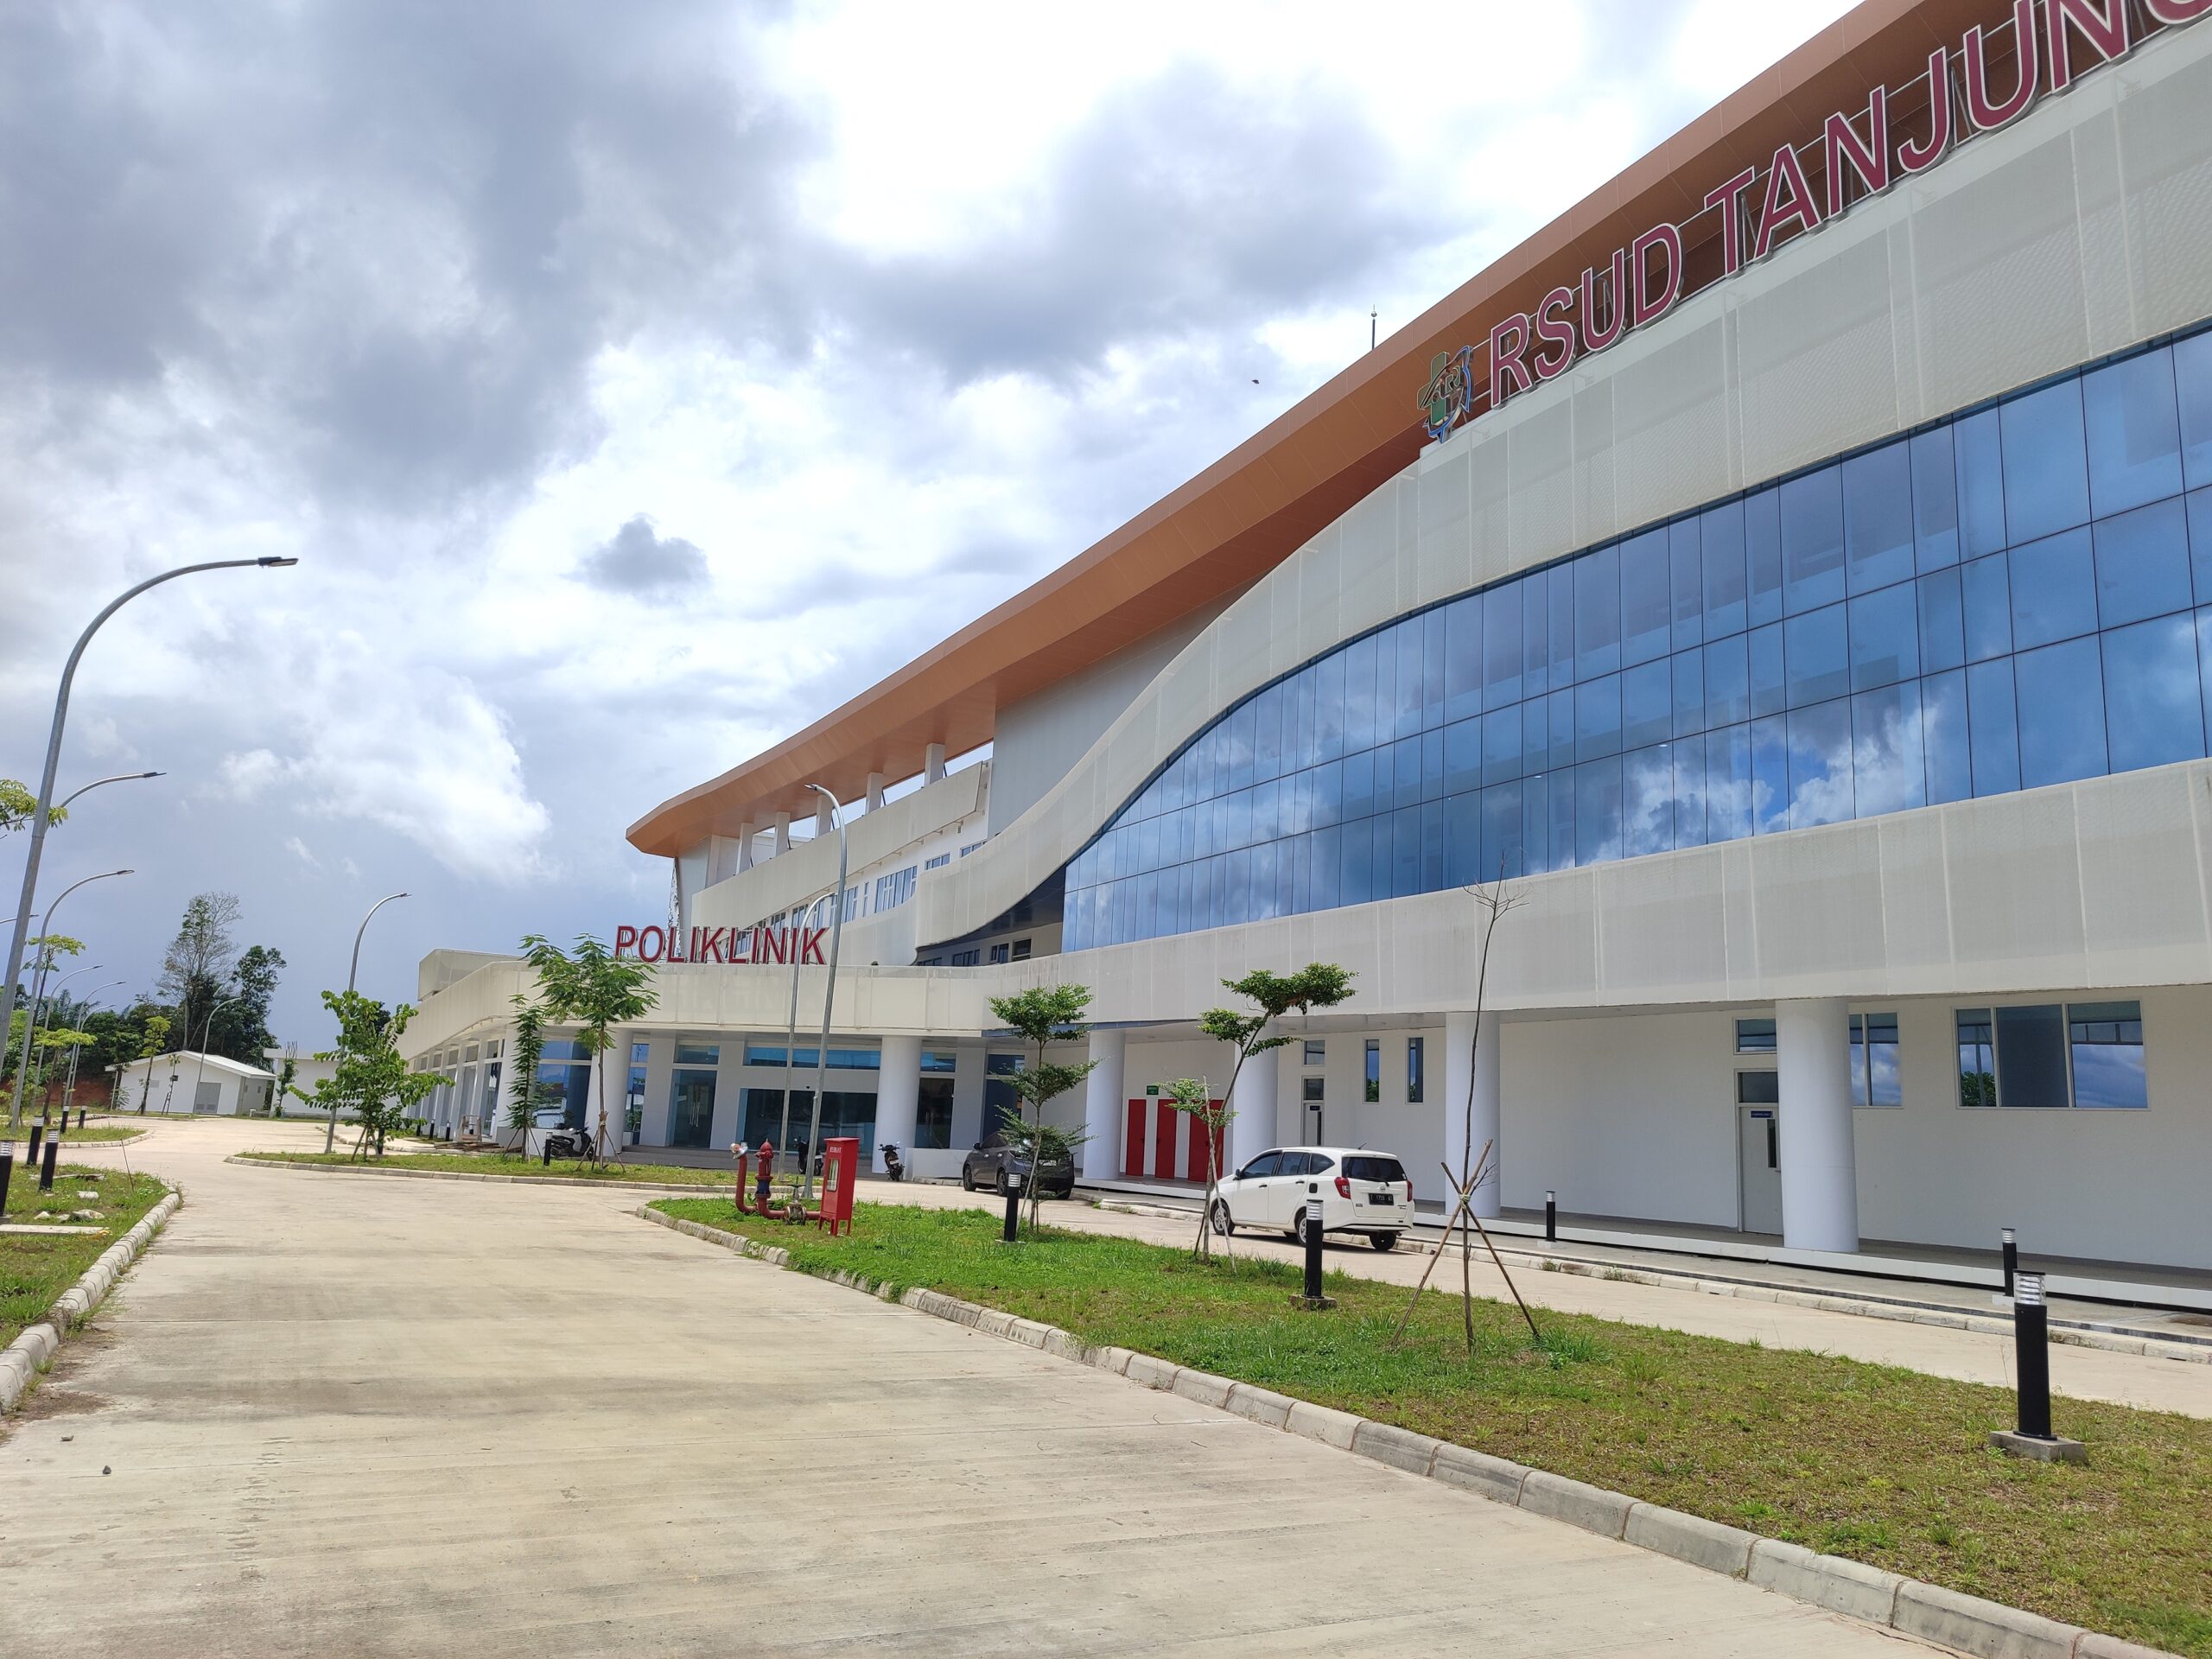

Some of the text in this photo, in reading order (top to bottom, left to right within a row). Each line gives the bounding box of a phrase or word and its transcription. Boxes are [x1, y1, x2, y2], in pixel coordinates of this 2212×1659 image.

[1491, 0, 2212, 409] RSUD TANJUN
[615, 925, 829, 965] POLIKLINIK
